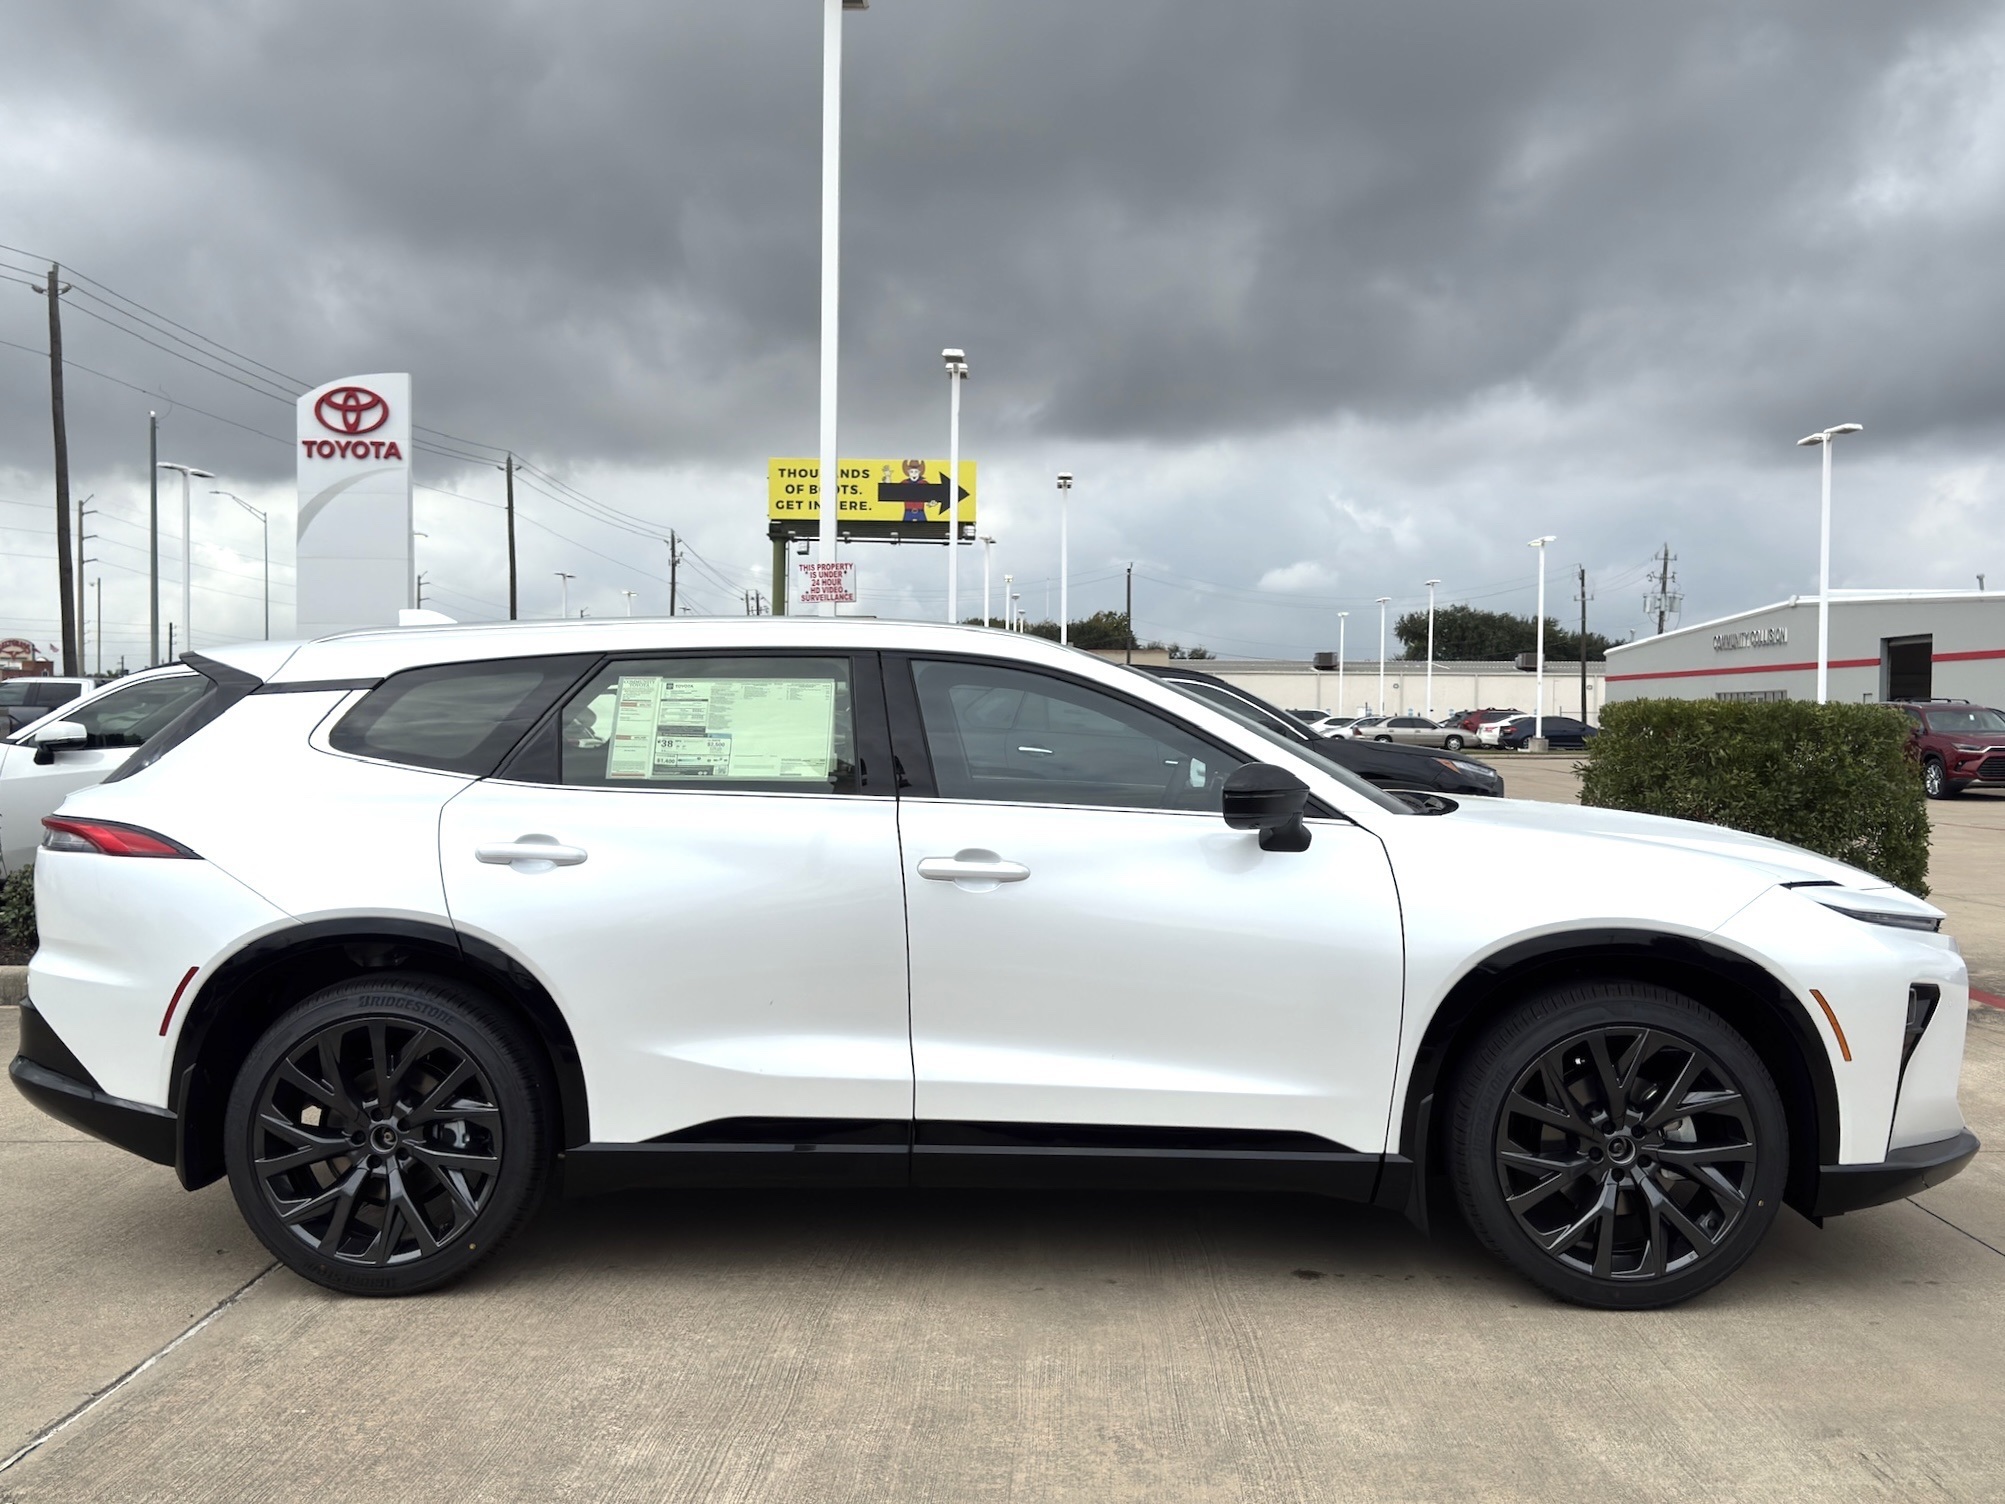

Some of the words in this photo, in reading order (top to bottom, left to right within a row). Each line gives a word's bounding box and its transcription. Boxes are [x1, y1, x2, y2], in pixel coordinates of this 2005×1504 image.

[302, 440, 402, 460] TOYOTA
[778, 468, 870, 479] THOUNDS
[785, 484, 804, 495] OF
[809, 484, 862, 495] BTS.
[775, 500, 803, 510] GET
[839, 501, 872, 511] ERE.
[817, 563, 853, 571] PROPERTY
[822, 586, 843, 594] VIDEO
[1751, 627, 1788, 648] COLLISION
[661, 739, 674, 748] 38
[359, 996, 455, 1025] BRIDGESTONE
